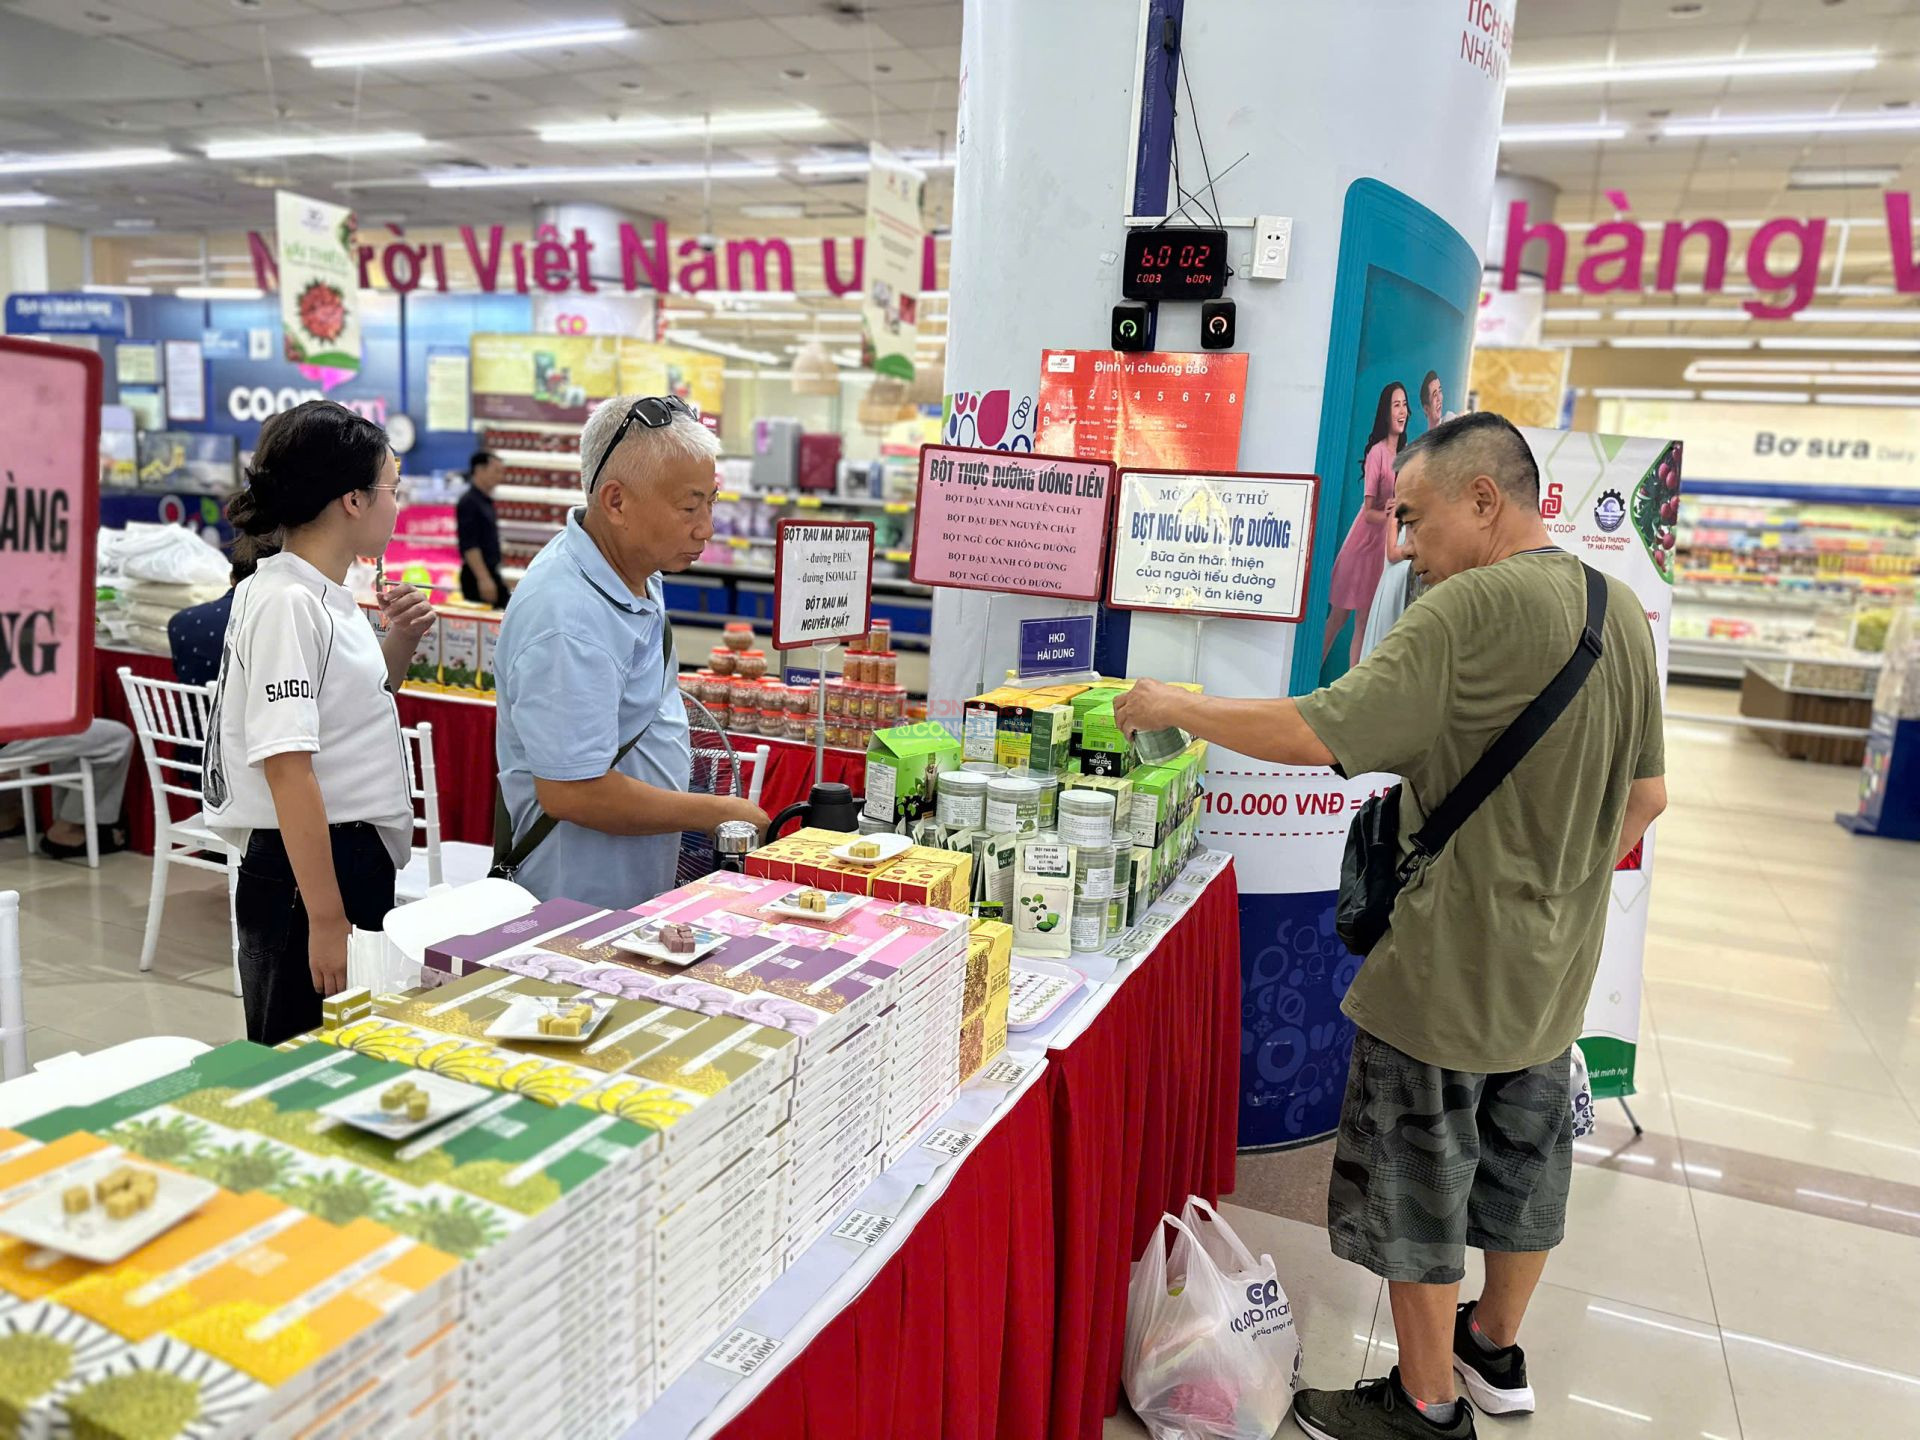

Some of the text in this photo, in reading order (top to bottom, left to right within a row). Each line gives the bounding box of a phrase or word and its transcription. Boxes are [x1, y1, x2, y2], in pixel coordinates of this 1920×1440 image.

[1460, 30, 1501, 81] NHẬN
[458, 220, 599, 294] Việt
[618, 219, 795, 294] Nam
[1499, 188, 1828, 320] hàng
[1094, 361, 1121, 375] Định
[1124, 362, 1135, 376] vị
[1137, 362, 1182, 377] chuông
[1088, 388, 1096, 400] 2
[1111, 389, 1119, 400] 3
[1133, 390, 1141, 401] 4
[1157, 391, 1165, 402] 5
[1182, 392, 1190, 402] 6
[1204, 392, 1211, 403] 7
[1228, 393, 1237, 404] 8
[1043, 402, 1051, 412] A
[1043, 416, 1050, 426] B
[930, 455, 955, 487] BỘT
[957, 462, 990, 491] THỰC
[1038, 463, 1074, 496] UỐNG
[1075, 467, 1105, 499] LIỀN
[988, 498, 1014, 509] XANH
[1016, 501, 1054, 512] NGUYÊN
[1236, 489, 1270, 506] THỬ
[1010, 520, 1049, 532] NGUYÊN
[1246, 511, 1292, 549] DƯỠNG
[784, 527, 801, 543] BỘT
[802, 528, 820, 541] RAU
[1007, 539, 1041, 550] KHÔNG
[810, 552, 832, 566] đường
[990, 556, 1016, 567] XANH
[1150, 551, 1175, 562] Bữa
[1178, 552, 1195, 564] ăn
[1231, 556, 1265, 570] thiện
[802, 571, 858, 585] đường ISOMALT
[1136, 565, 1276, 589] của người tiểu đường
[805, 594, 820, 611] BỘT
[822, 597, 835, 609] RAU
[1204, 587, 1222, 599] ăn
[1225, 589, 1263, 605] kiêng
[801, 611, 850, 631] NGUYÊN CHẤT
[1048, 632, 1066, 643] HKD
[1052, 647, 1075, 659] DUNG
[265, 679, 314, 703] SAIGO
[1204, 792, 1288, 816] 10.000
[1295, 793, 1345, 815] VNĐ
[1272, 1322, 1286, 1332] mọi
